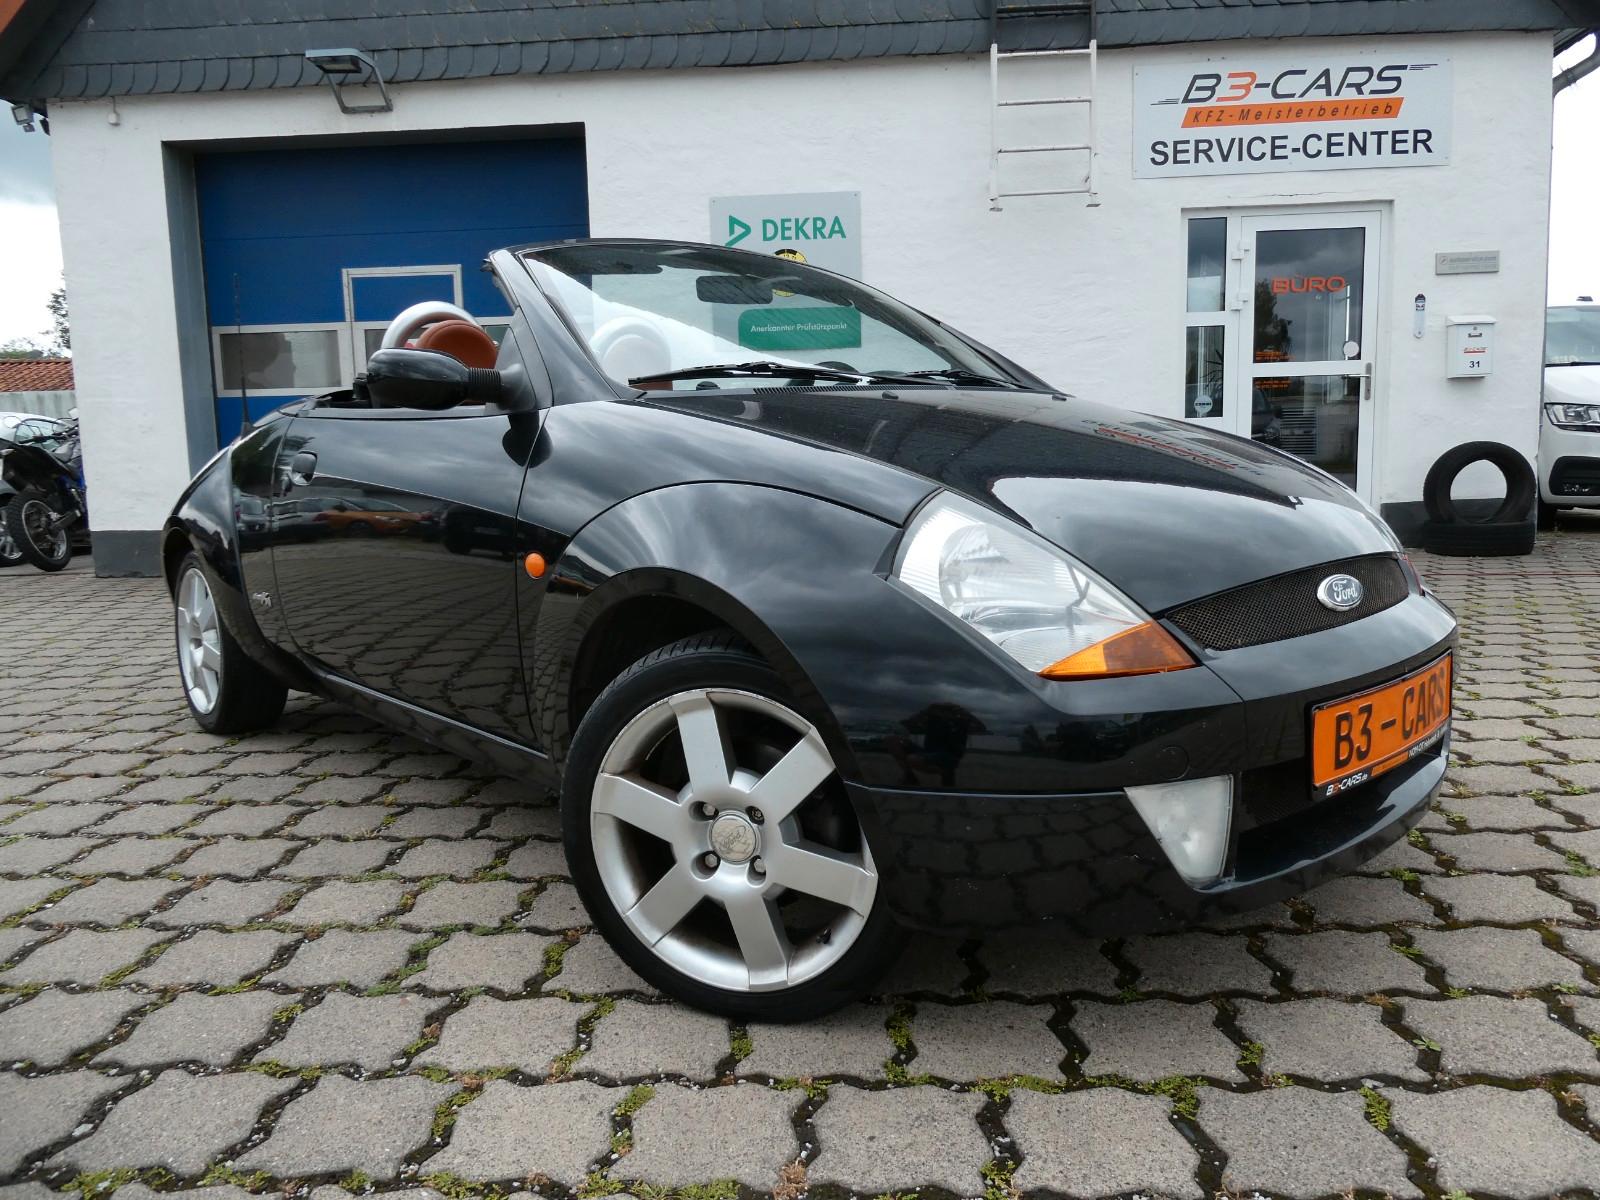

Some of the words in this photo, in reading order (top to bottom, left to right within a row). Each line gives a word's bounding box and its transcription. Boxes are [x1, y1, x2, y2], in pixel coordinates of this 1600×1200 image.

[1181, 64, 1409, 104] B3-CARS
[1193, 102, 1393, 123] KFZ-Meisterbetrieb
[1150, 128, 1433, 166] SERVICE-CENTER
[761, 215, 847, 242] DEKRA
[750, 324, 795, 333] Anerkannter
[1468, 360, 1480, 369] 31
[1332, 579, 1358, 601] Ford
